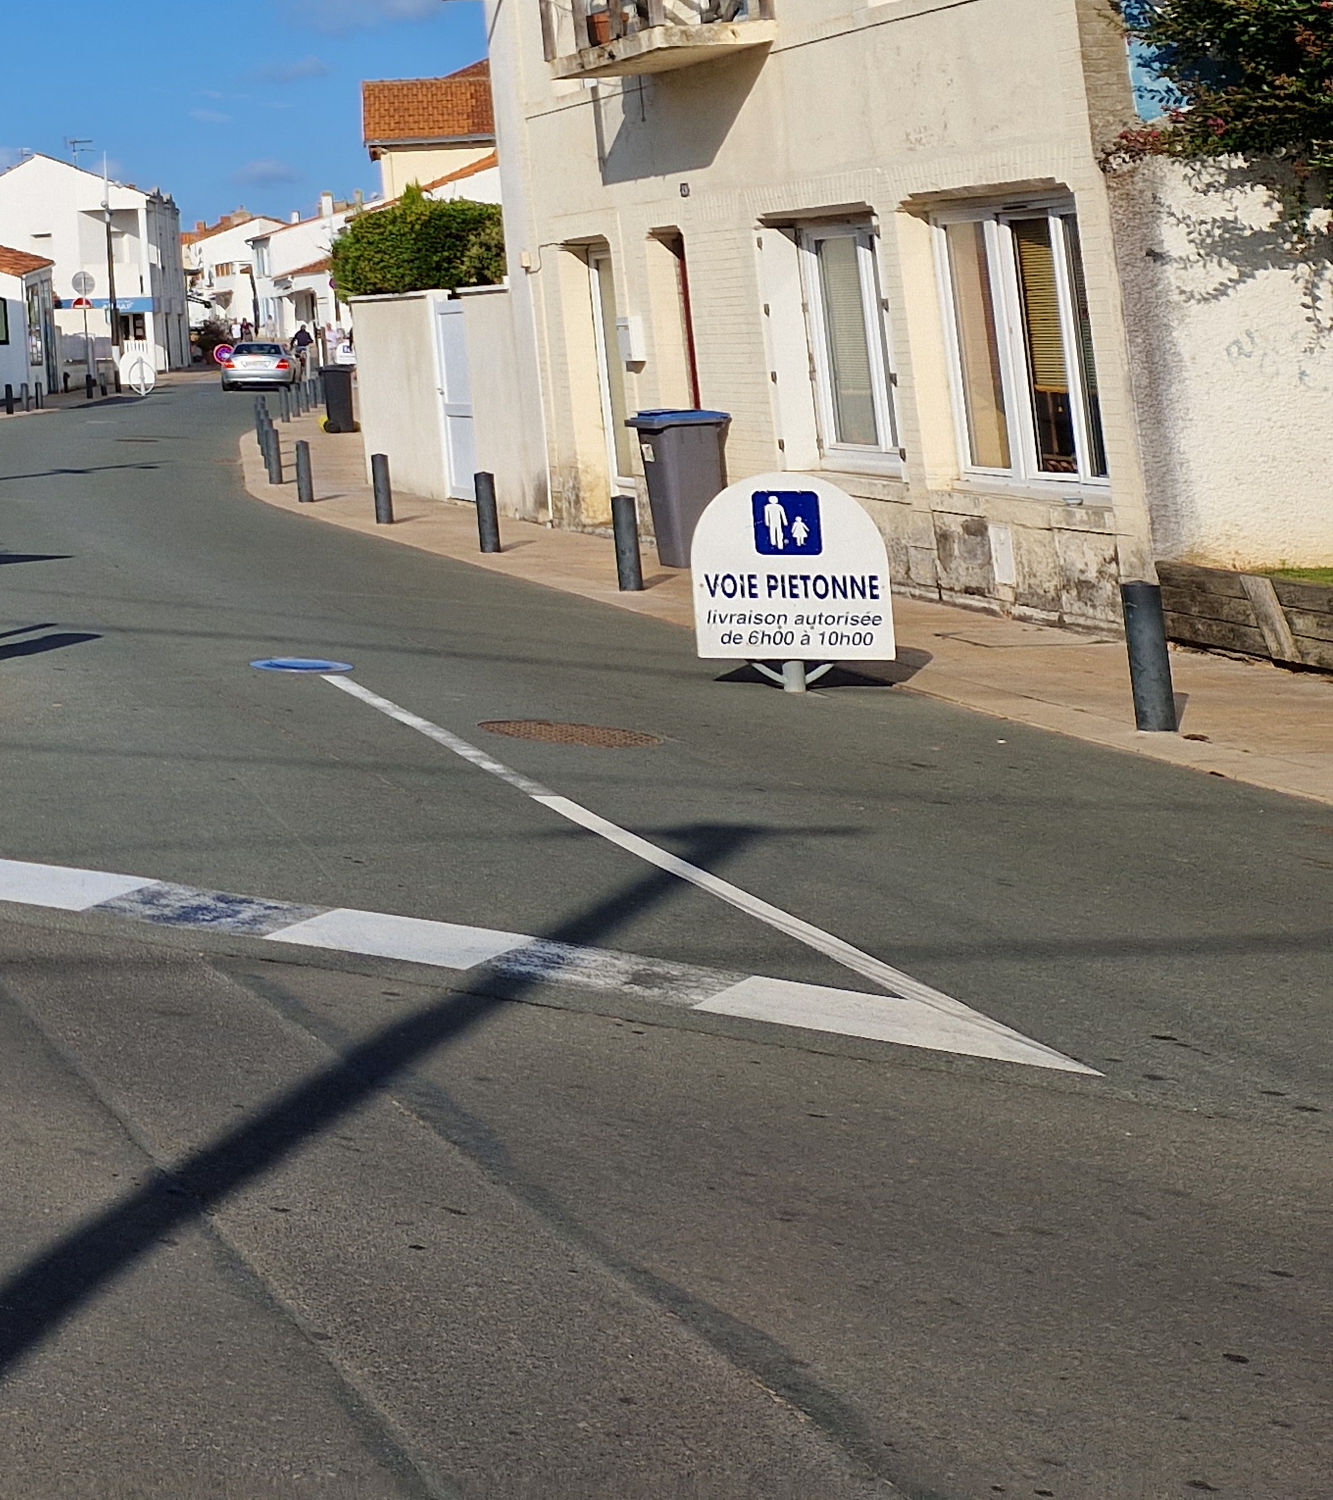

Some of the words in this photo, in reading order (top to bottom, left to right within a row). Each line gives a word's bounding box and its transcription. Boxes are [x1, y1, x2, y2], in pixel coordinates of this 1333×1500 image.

[704, 574, 759, 598] VOIE
[767, 574, 880, 600] PIETONNE
[707, 610, 788, 626] livraison
[794, 611, 883, 626] autorisée
[720, 631, 743, 645] de
[748, 631, 794, 645] 6h00
[800, 630, 811, 646] à
[820, 631, 874, 647] 10h00
